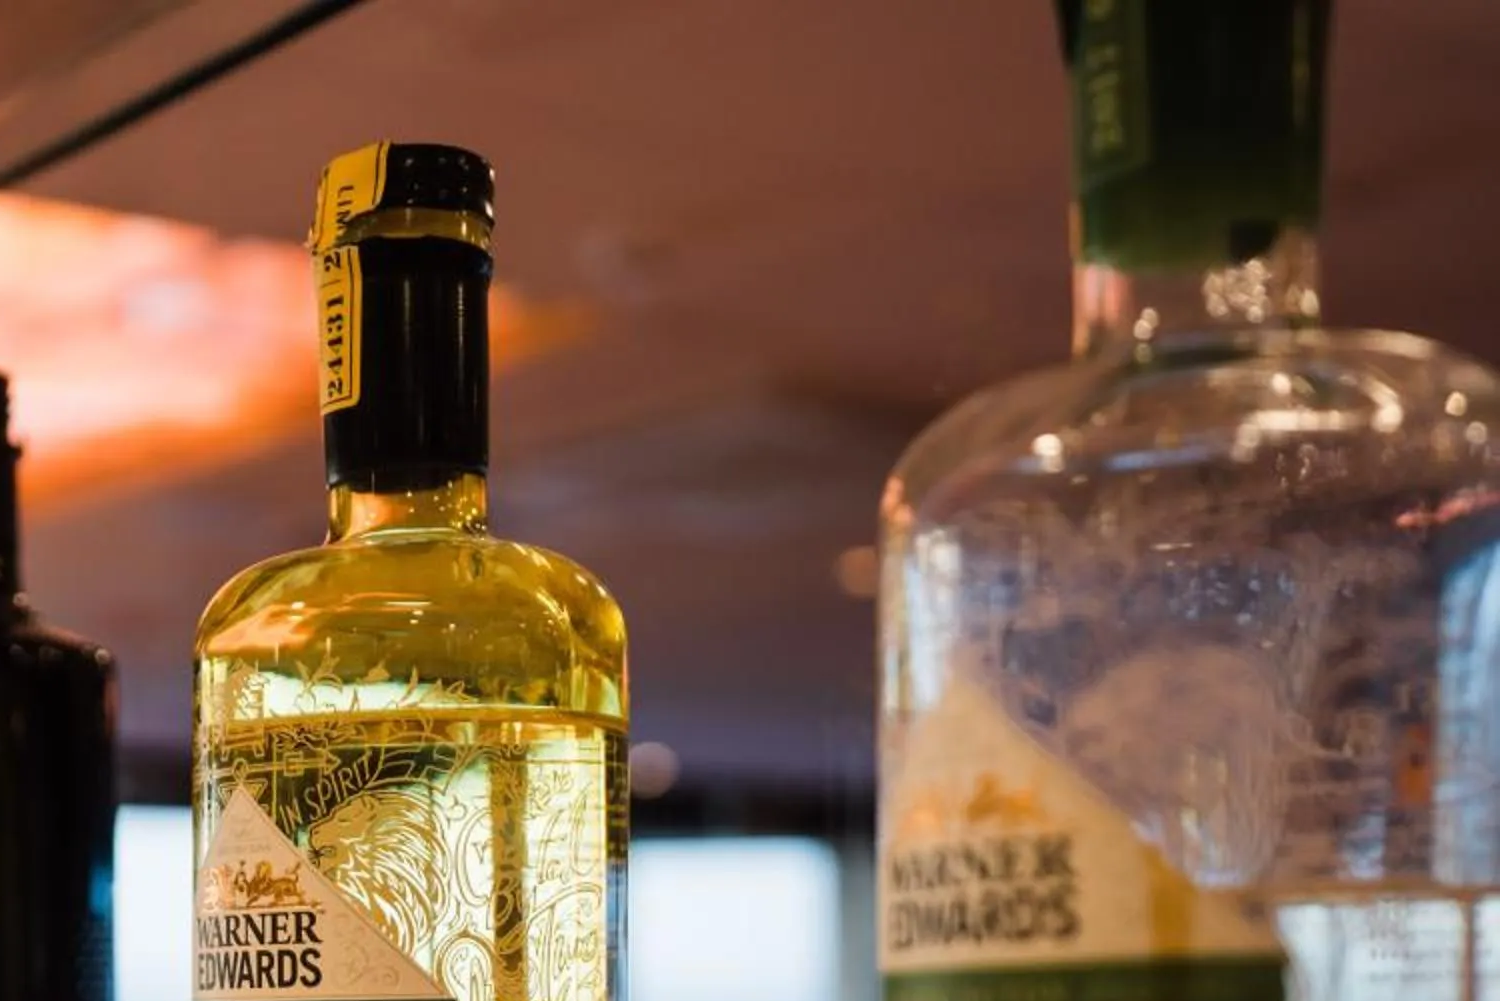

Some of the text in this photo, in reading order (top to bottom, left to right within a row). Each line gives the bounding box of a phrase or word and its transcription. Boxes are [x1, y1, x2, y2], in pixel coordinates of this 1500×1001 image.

[327, 296, 344, 398] 24431
[304, 751, 373, 820] SPIRIT
[198, 911, 323, 948] WARNER
[198, 948, 322, 990] EDWARDS
